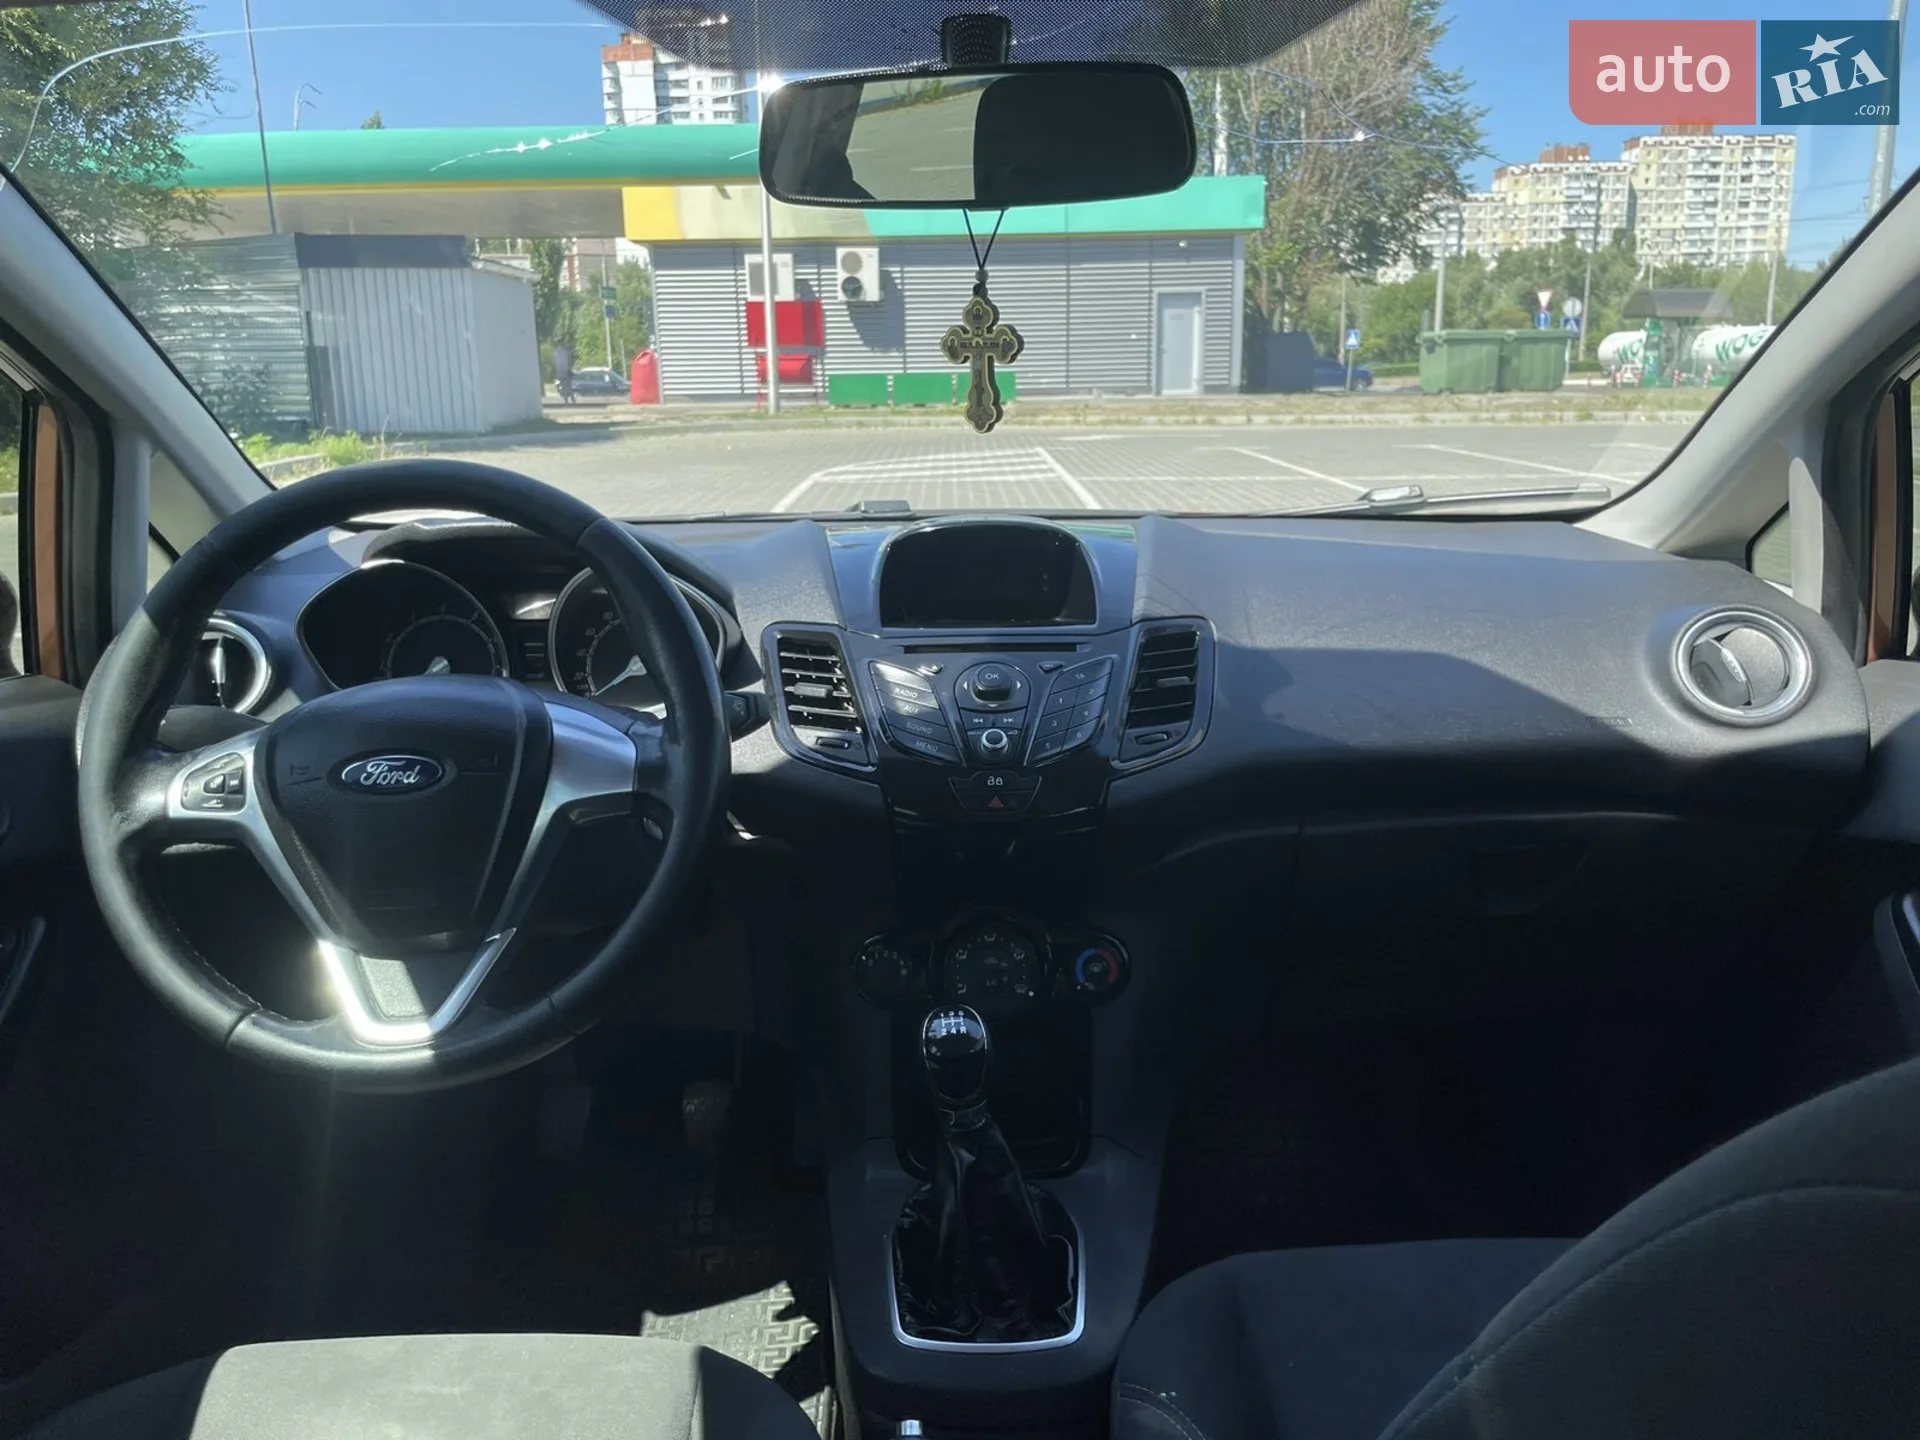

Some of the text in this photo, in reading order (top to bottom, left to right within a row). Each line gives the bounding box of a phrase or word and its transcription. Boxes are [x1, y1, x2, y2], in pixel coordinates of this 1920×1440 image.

[985, 672, 1000, 680] OK
[893, 687, 918, 699] RADIO
[904, 705, 920, 714] AUX
[906, 721, 932, 734] SOUND
[915, 739, 939, 753] MENU
[360, 760, 422, 786] Ford
[940, 1025, 967, 1036] 2 4 R
